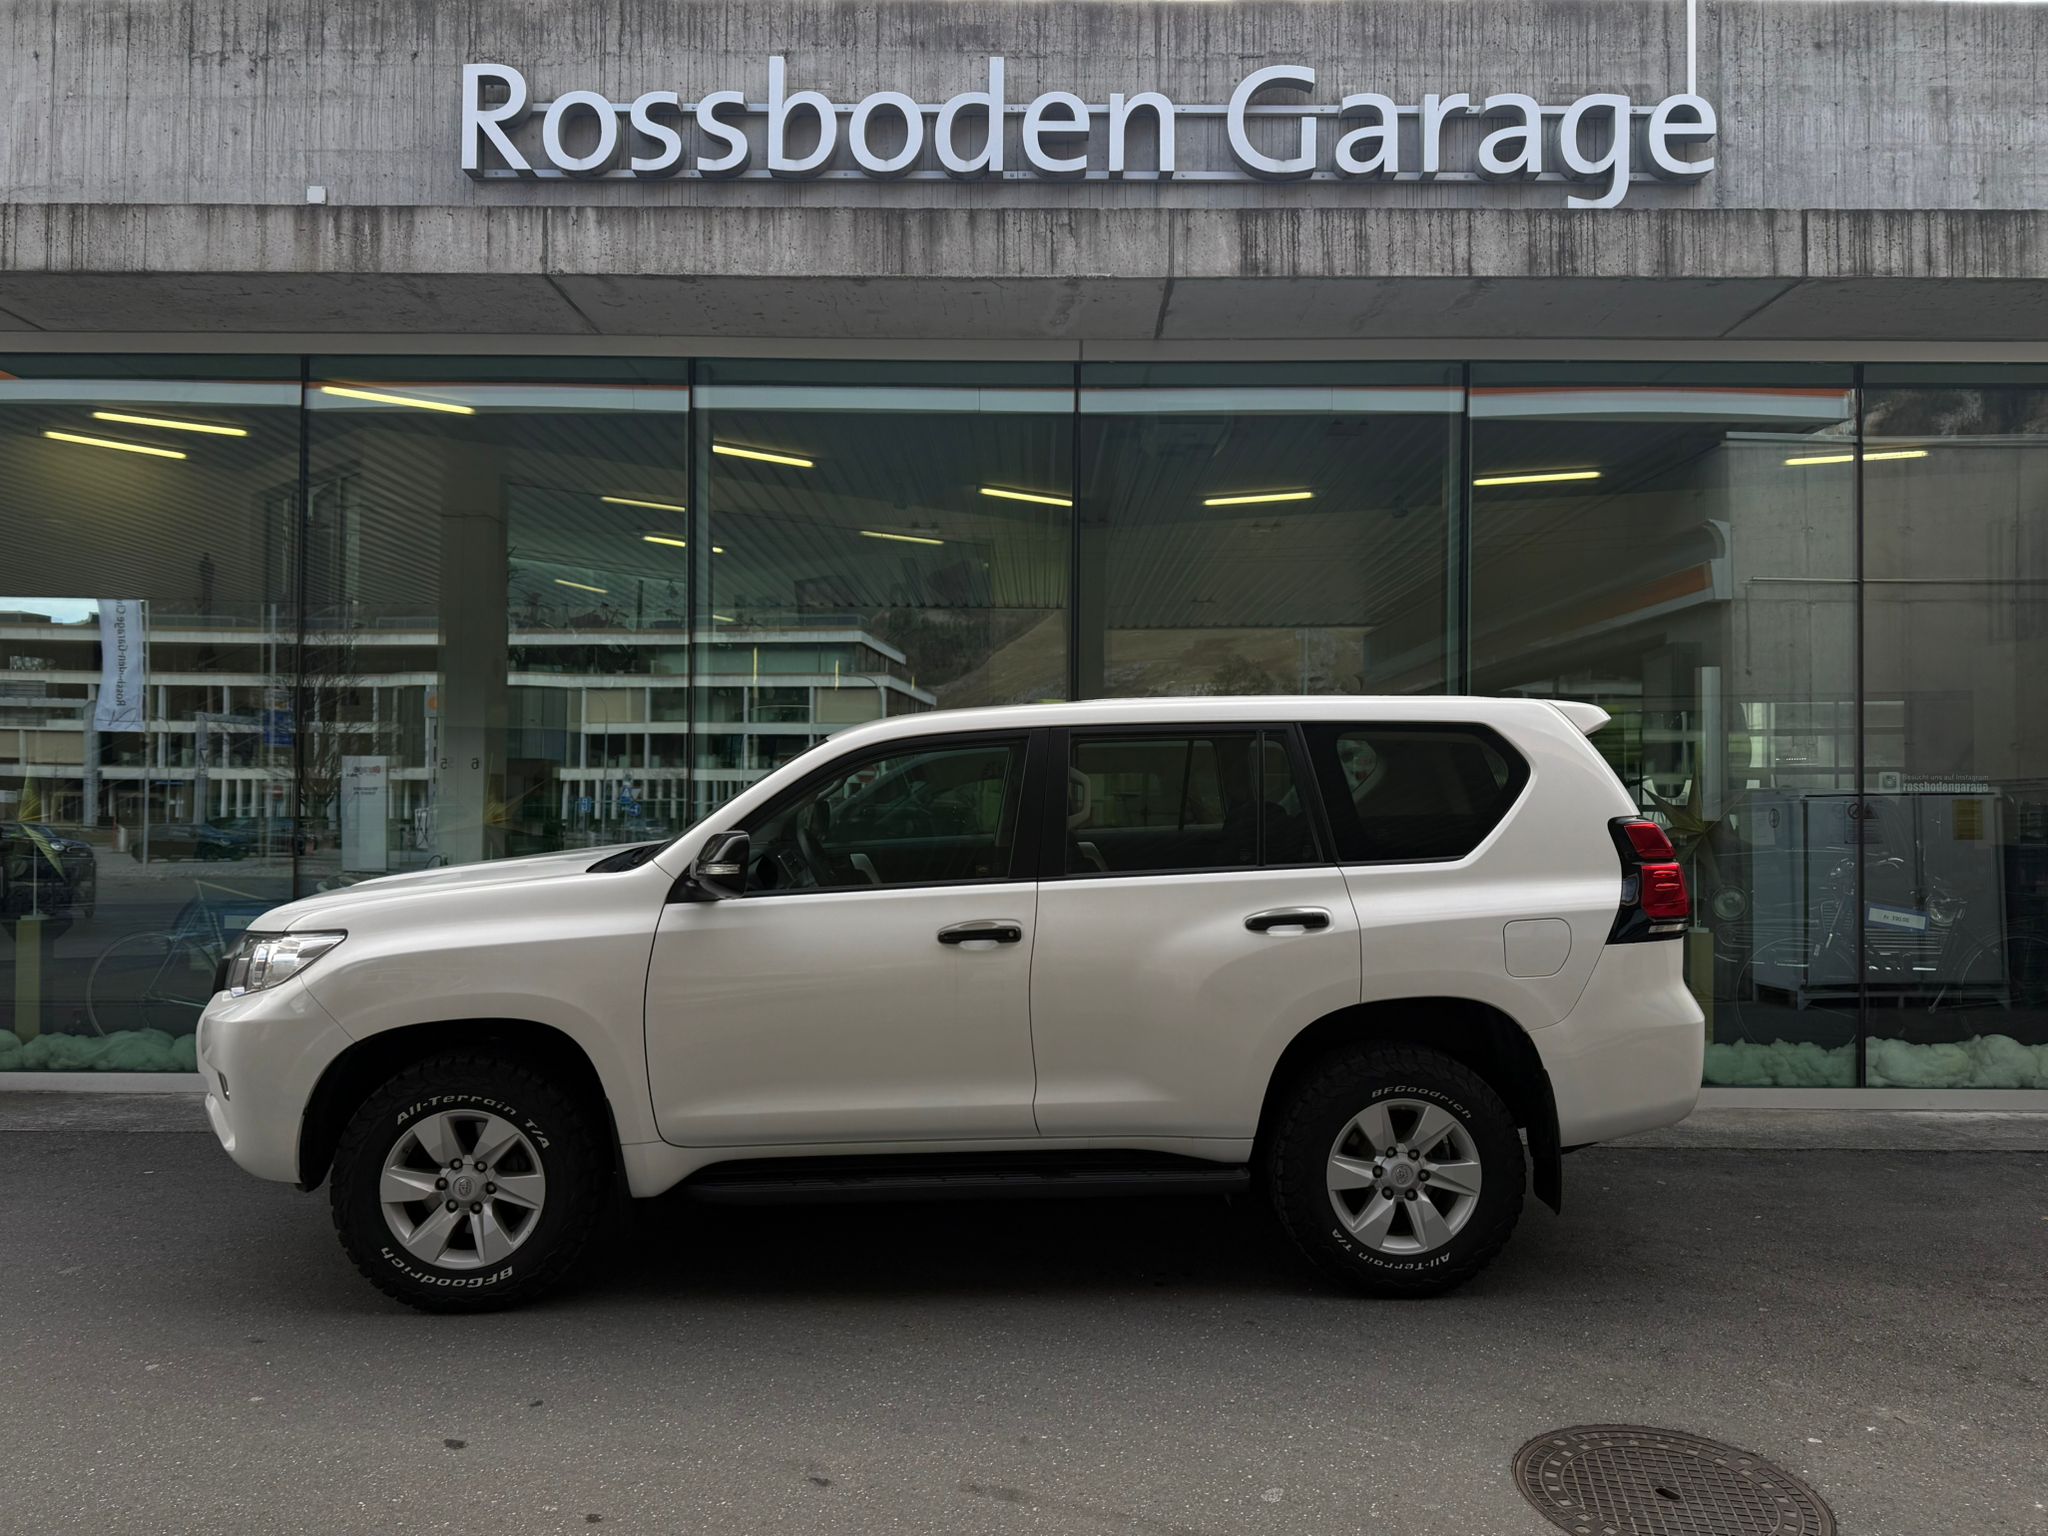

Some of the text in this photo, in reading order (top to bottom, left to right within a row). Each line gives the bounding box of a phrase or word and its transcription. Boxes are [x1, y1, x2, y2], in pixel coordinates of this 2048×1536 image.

[461, 56, 1717, 209] Rossboden Garage
[1902, 781, 1989, 794] rossbodengarage
[396, 1093, 551, 1150] All-Terrain T/A
[1371, 1085, 1472, 1120] BFGoodrich
[380, 1246, 513, 1289] BFGoodrich
[1330, 1228, 1451, 1271] All-Terrain T/A
